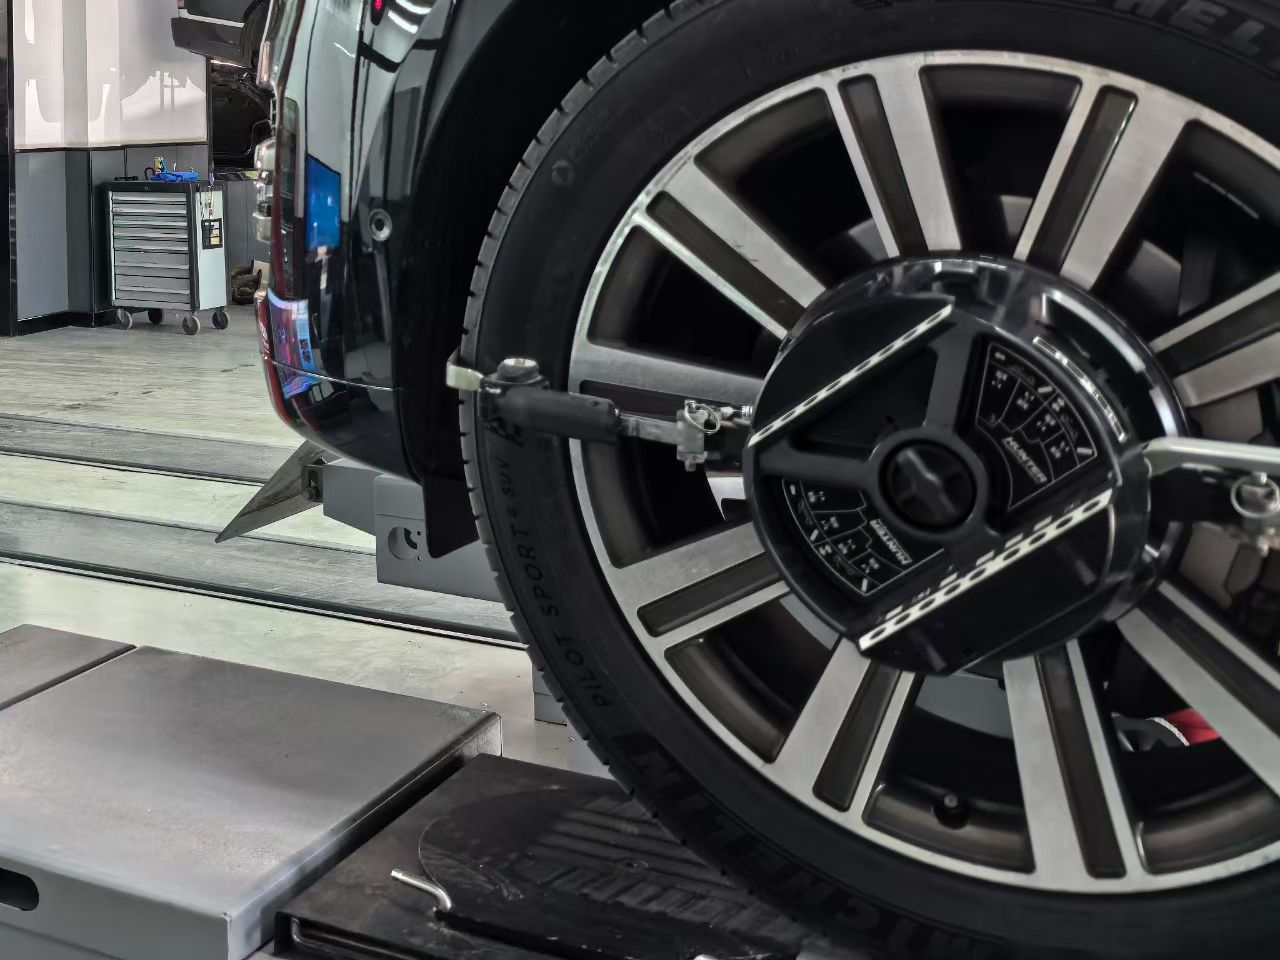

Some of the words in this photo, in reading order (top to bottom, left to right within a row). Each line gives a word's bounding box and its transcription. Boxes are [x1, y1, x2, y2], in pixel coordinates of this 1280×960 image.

[498, 457, 515, 498] SUV
[510, 526, 560, 618] SPORT
[557, 635, 614, 708] PILOT
